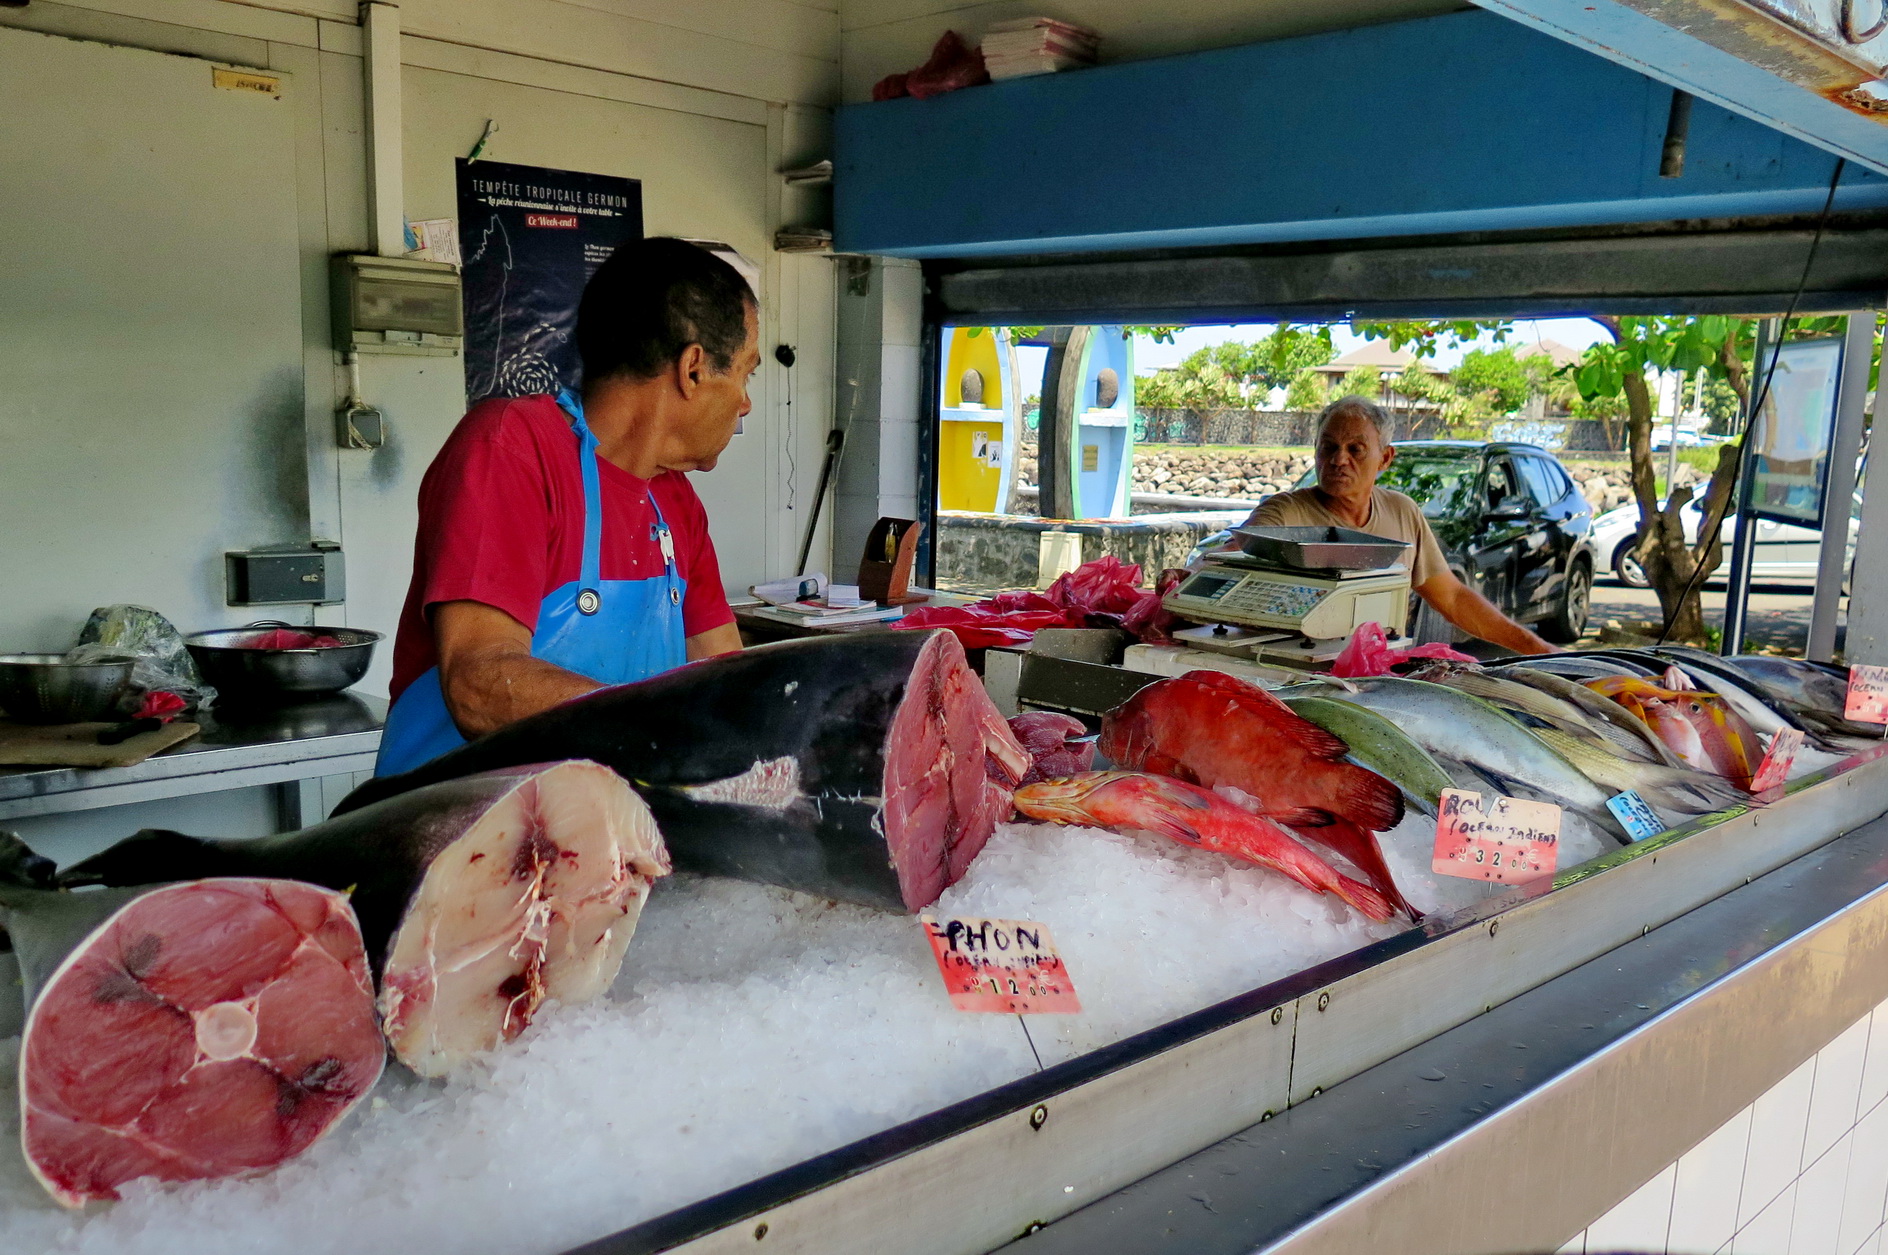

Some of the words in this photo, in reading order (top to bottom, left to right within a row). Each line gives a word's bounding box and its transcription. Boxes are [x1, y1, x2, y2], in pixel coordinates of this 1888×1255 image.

[473, 179, 520, 197] TEMPÊTE
[526, 185, 582, 204] TROPICALE
[587, 192, 627, 208] GERMON
[583, 207, 598, 216] votre
[598, 208, 614, 217] table
[528, 215, 537, 226] Ce
[538, 215, 573, 227] Week-end
